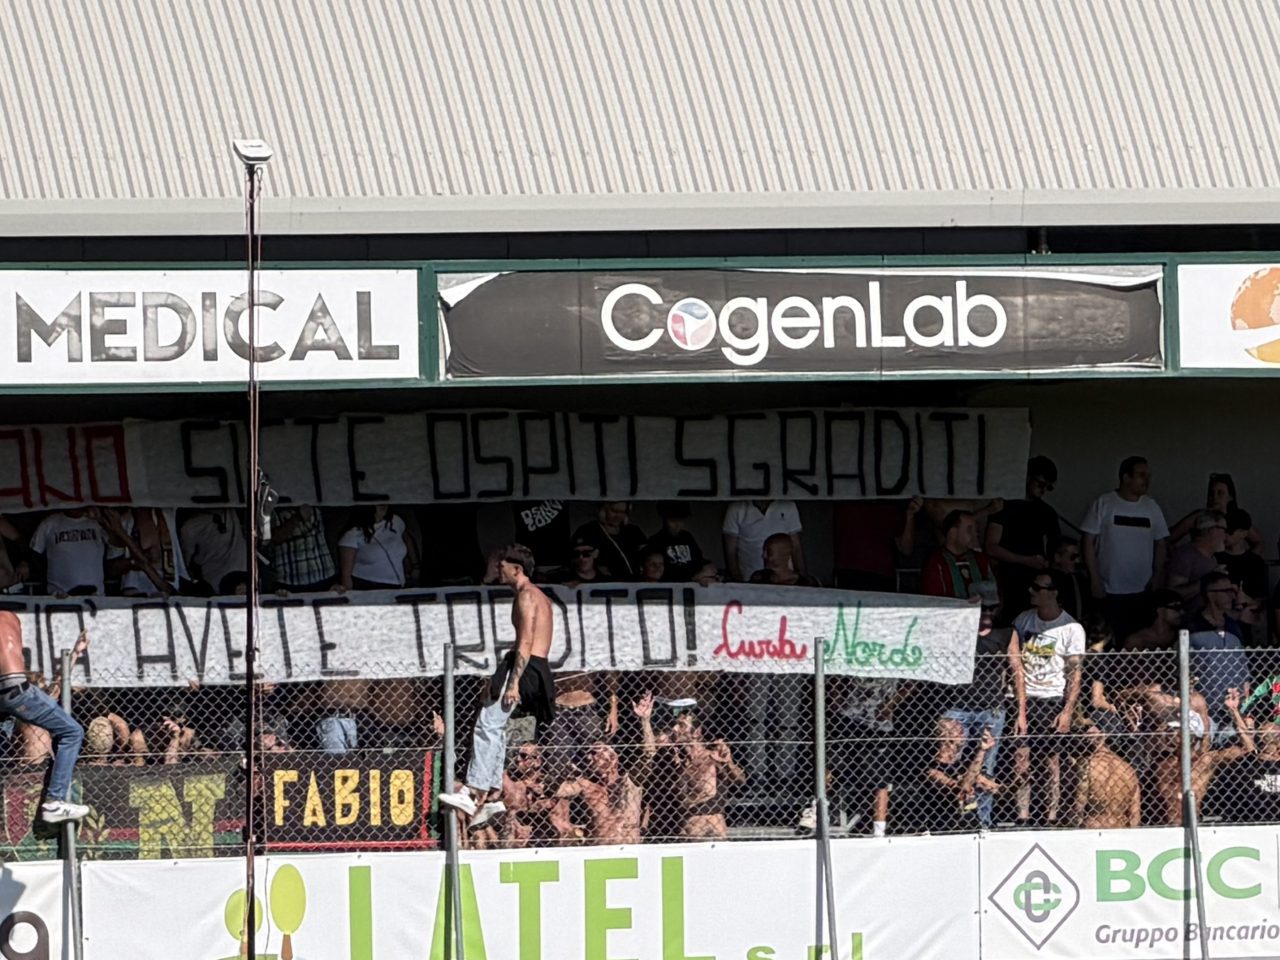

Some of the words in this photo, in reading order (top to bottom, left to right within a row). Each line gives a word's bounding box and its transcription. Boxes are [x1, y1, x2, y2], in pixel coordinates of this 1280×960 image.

[17, 289, 401, 365] MEDICAL
[601, 279, 1008, 366] CogenLab
[428, 410, 638, 500] OSPITI
[675, 408, 986, 498] SGRADITI
[133, 597, 360, 681] AVETE
[273, 769, 414, 827] FABIO
[1096, 846, 1262, 903] BCC
[1095, 924, 1179, 949] Gruppo
